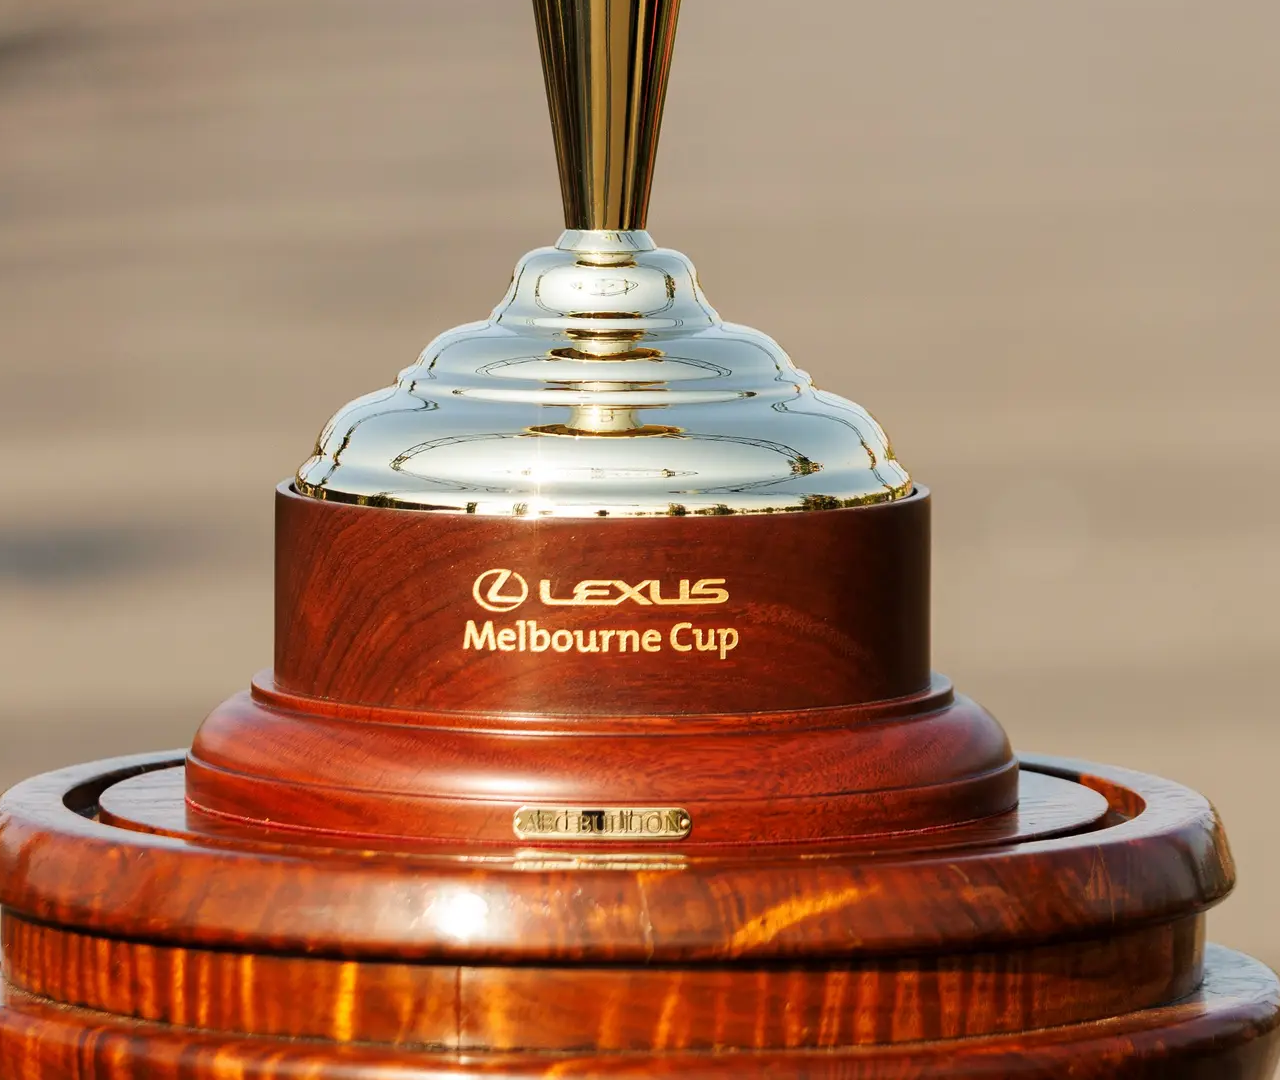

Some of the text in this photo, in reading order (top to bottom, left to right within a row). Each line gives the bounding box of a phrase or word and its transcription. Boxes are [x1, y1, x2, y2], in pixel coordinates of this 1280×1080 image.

[540, 578, 730, 606] LEXUS
[462, 619, 739, 660] Melbourne Cup
[577, 814, 681, 834] BULLION
